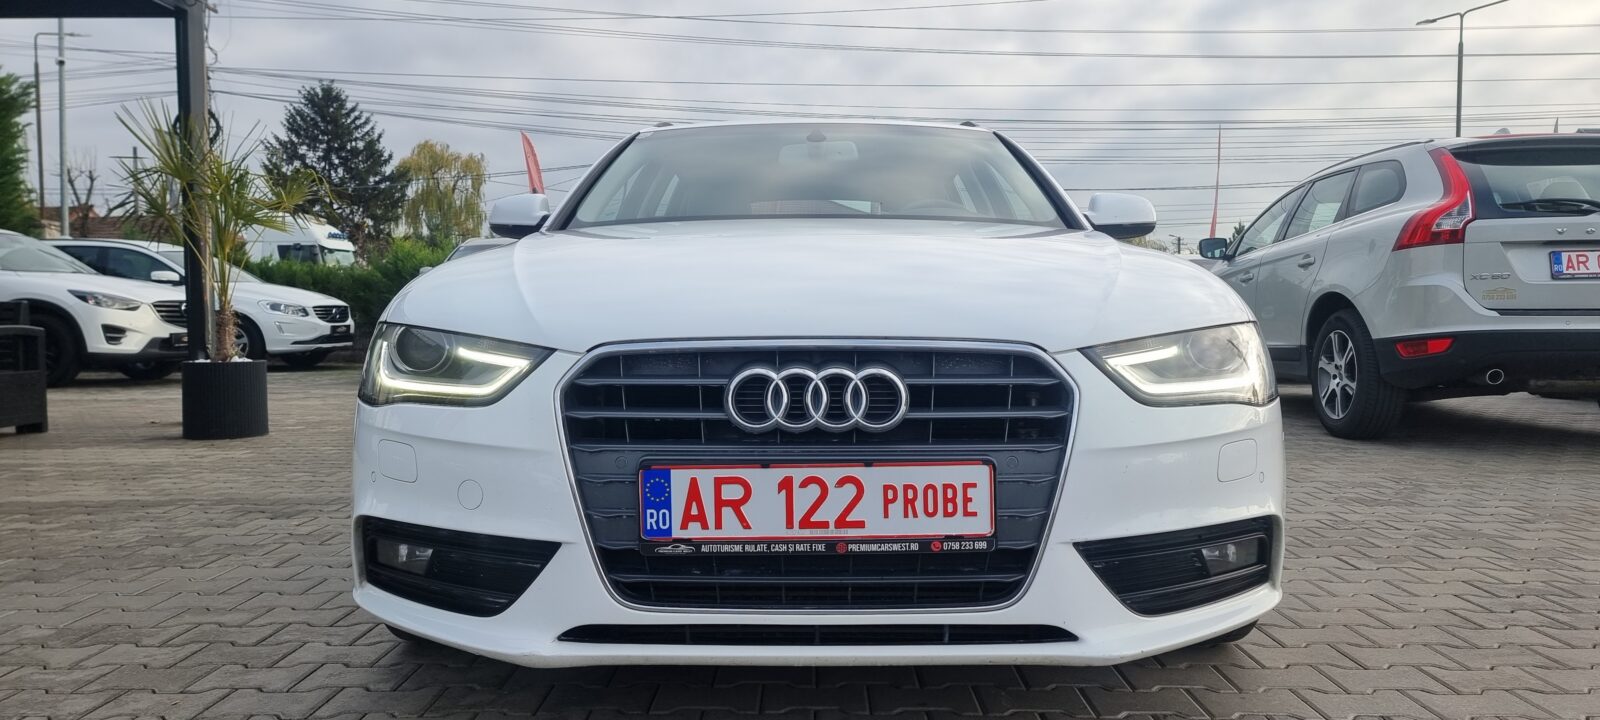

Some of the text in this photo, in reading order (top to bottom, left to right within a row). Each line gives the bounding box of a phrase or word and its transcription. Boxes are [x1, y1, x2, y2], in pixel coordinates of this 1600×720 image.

[1565, 254, 1590, 271] AR
[1554, 264, 1563, 272] RO
[679, 475, 978, 531] AR 122 PROBE
[646, 509, 670, 530] RO
[701, 544, 744, 553] AUTOTURISME
[771, 543, 788, 552] CASH
[795, 543, 811, 552] RATE
[812, 543, 826, 552] FIXE
[848, 543, 919, 552] PREMIUMCARSWEST.RO
[943, 541, 987, 550] 0758 233 699
